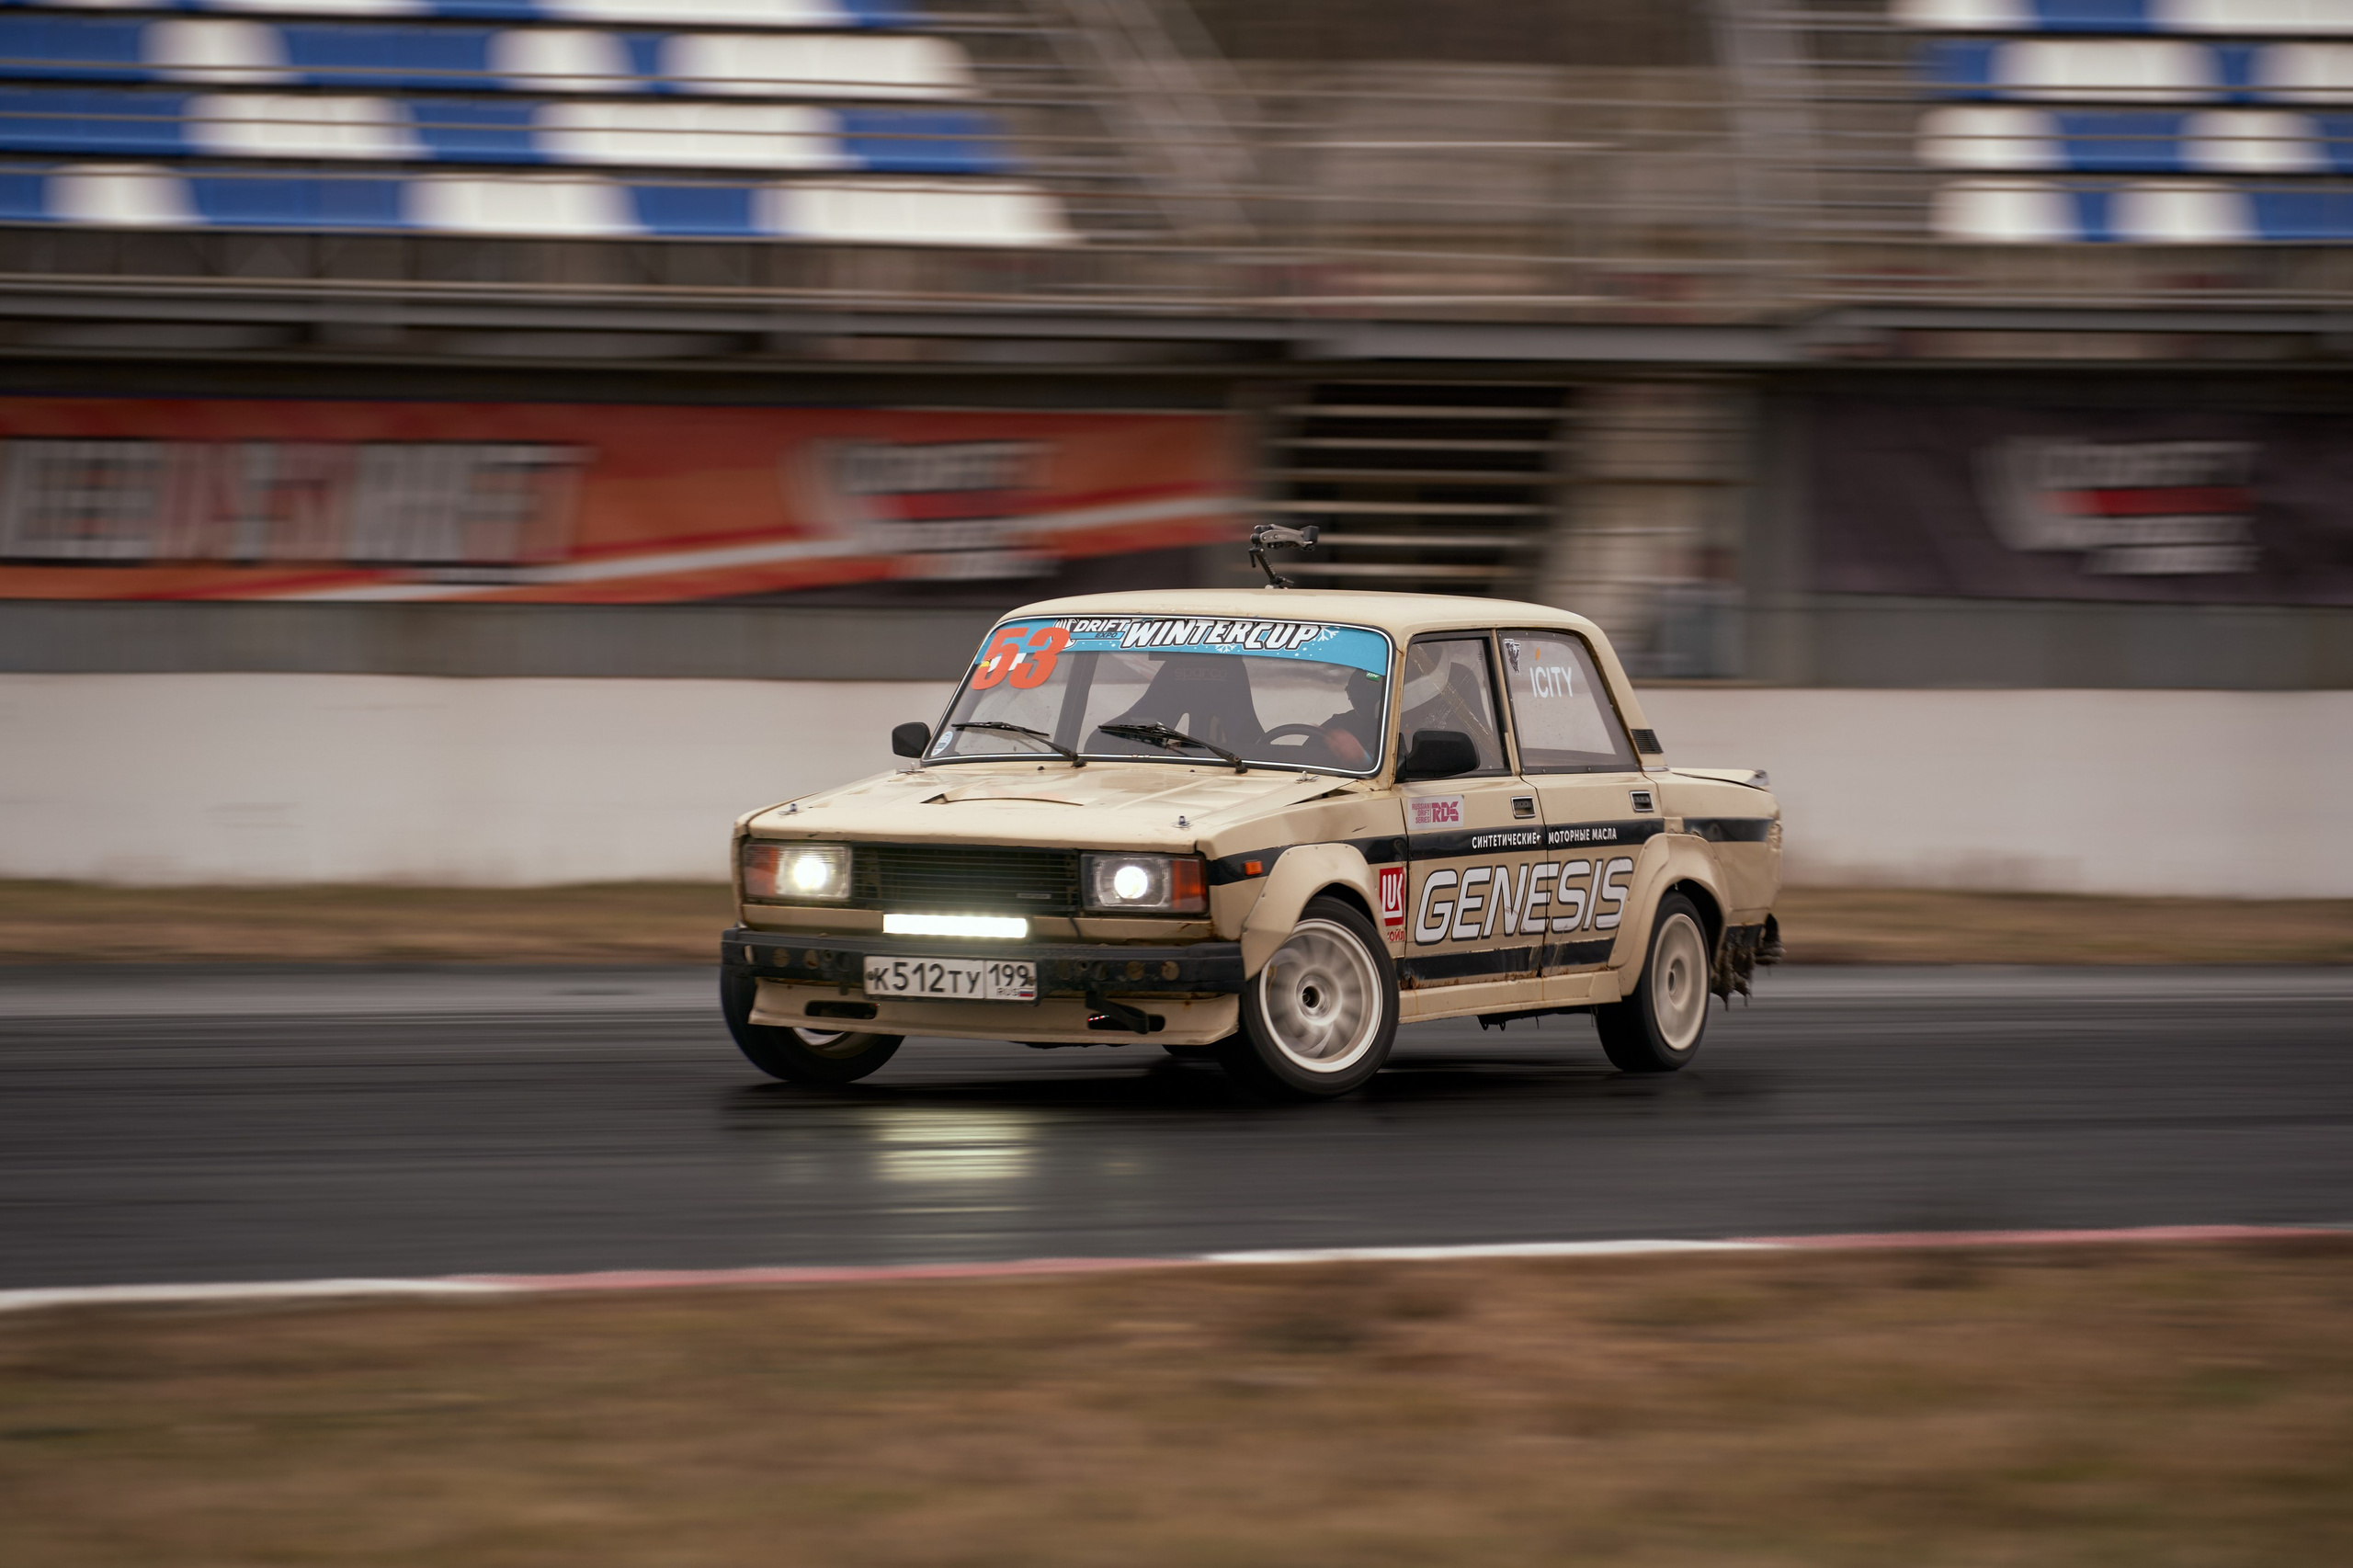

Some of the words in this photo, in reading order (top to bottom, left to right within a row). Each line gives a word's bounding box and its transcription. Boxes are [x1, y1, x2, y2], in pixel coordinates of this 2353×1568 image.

[1073, 619, 1131, 632] DRIFT
[971, 627, 1070, 690] 53
[1175, 667, 1228, 681] sparco
[1529, 666, 1573, 699] ICITY
[1432, 801, 1459, 823] RDS
[1472, 832, 1537, 849] СИНТЕТИЧЕСКИЕ
[1548, 828, 1590, 845] МОТОРНЫЕ
[1591, 827, 1618, 841] МАСЛА
[1415, 856, 1634, 946] GENESIS
[988, 963, 1029, 987] 199
